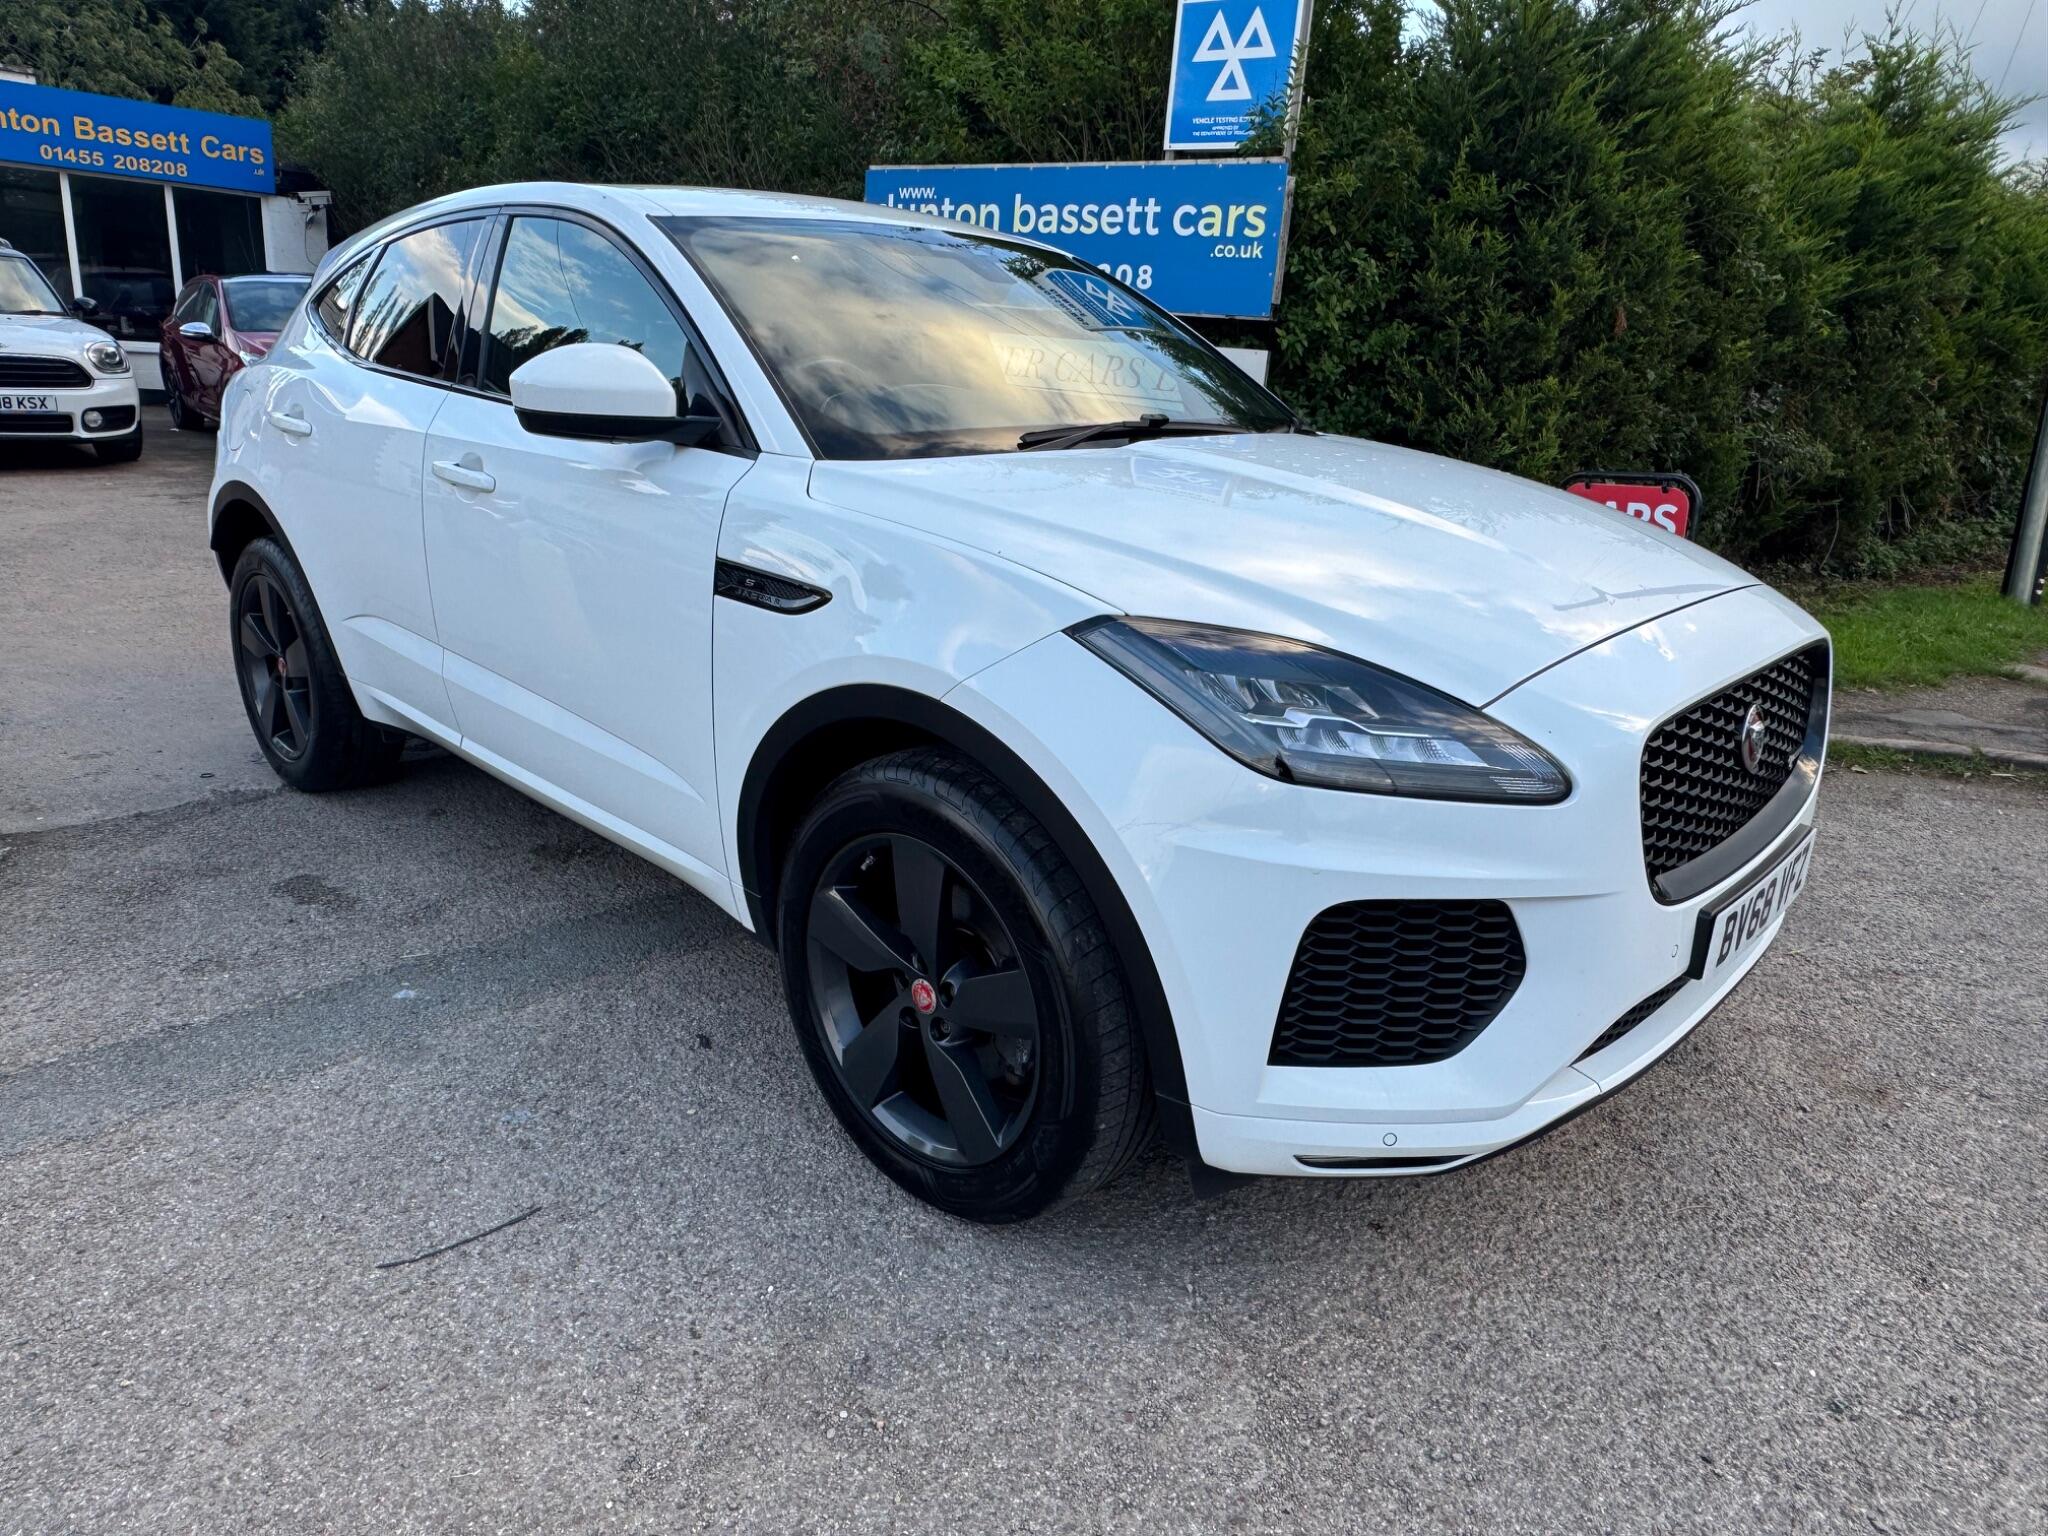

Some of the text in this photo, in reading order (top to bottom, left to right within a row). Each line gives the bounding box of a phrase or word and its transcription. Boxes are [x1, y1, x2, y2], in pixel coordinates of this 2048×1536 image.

[1216, 116, 1238, 124] TESTING
[73, 115, 190, 154] Bassett
[200, 135, 265, 164] Cars
[40, 144, 188, 177] 01455 208208
[899, 187, 937, 199] www.
[1012, 193, 1161, 236] bassett
[1172, 204, 1267, 238] cars
[1209, 241, 1263, 259] .co.uk
[1054, 352, 1145, 388] CARS
[16, 396, 48, 409] KSX
[1716, 841, 1811, 968] BV68 VFZ
